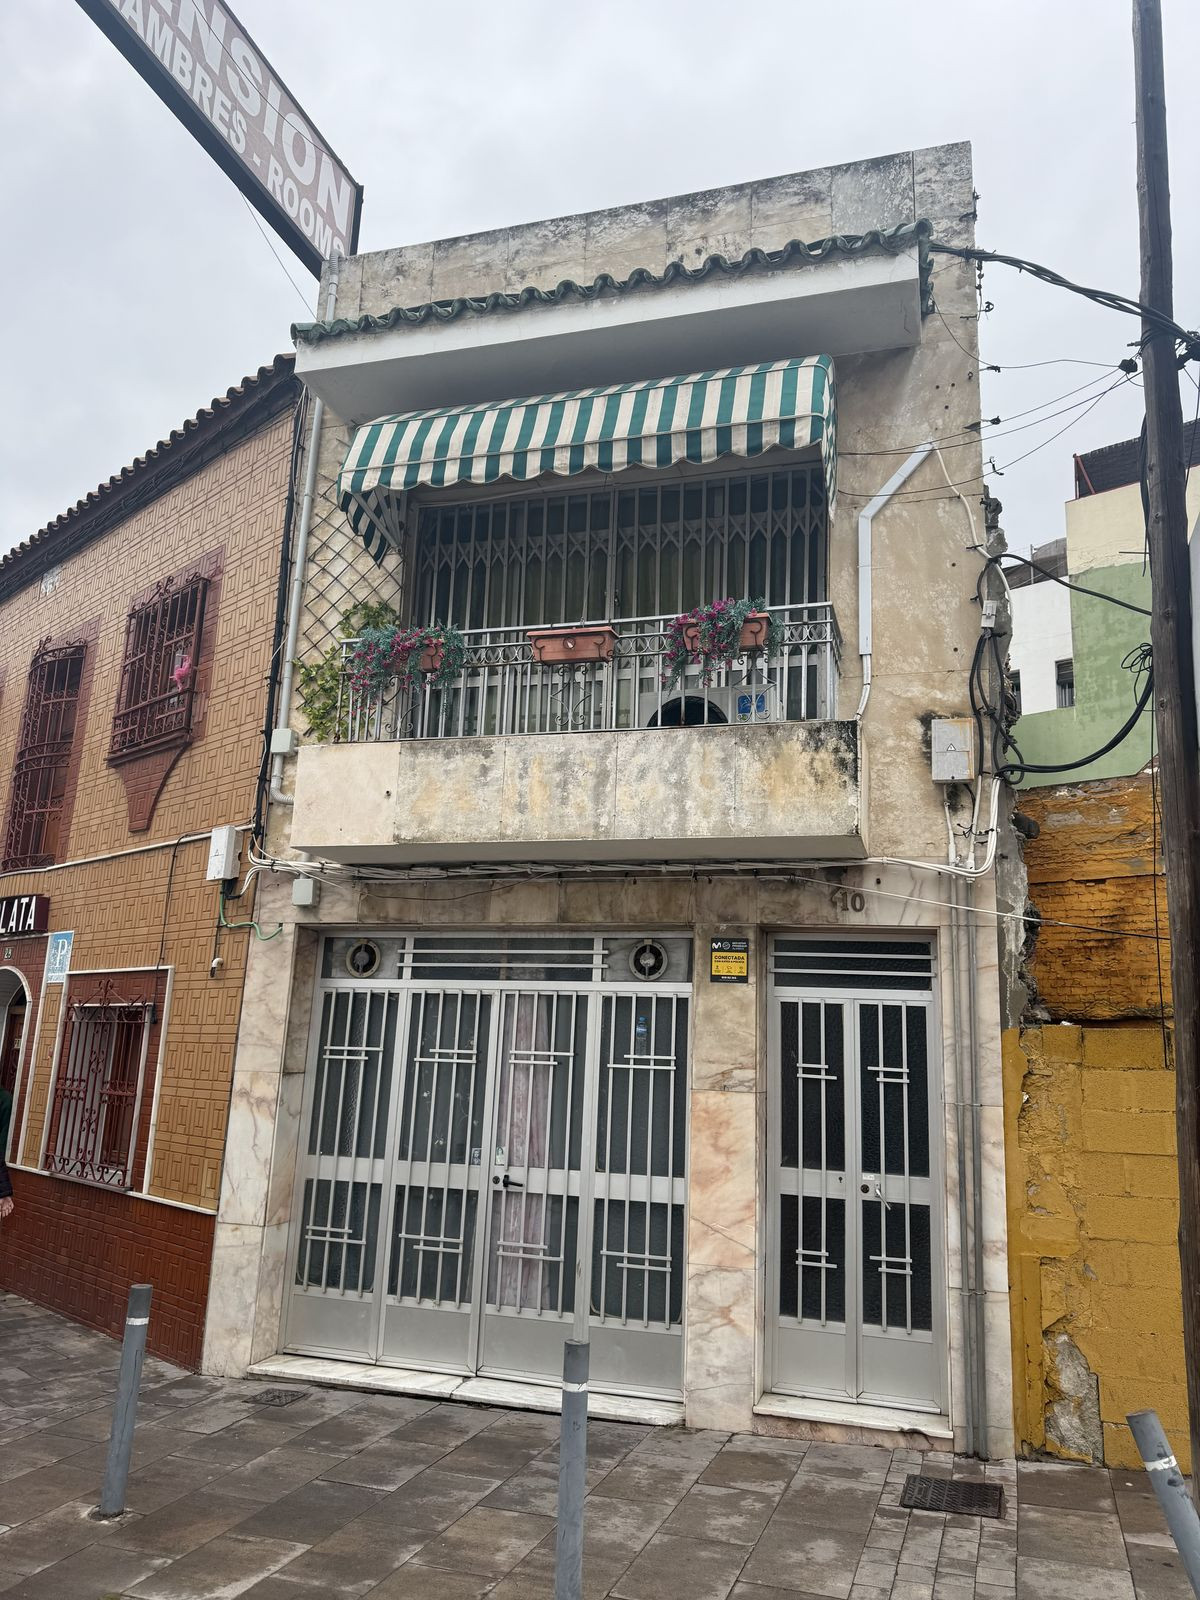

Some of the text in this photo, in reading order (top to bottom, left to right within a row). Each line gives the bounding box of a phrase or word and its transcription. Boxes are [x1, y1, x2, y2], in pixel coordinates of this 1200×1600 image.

[111, 0, 247, 154] AMBRES
[157, 0, 351, 236] NSION
[0, 895, 36, 934] LATA
[840, 891, 865, 912] 10
[54, 938, 68, 968] P
